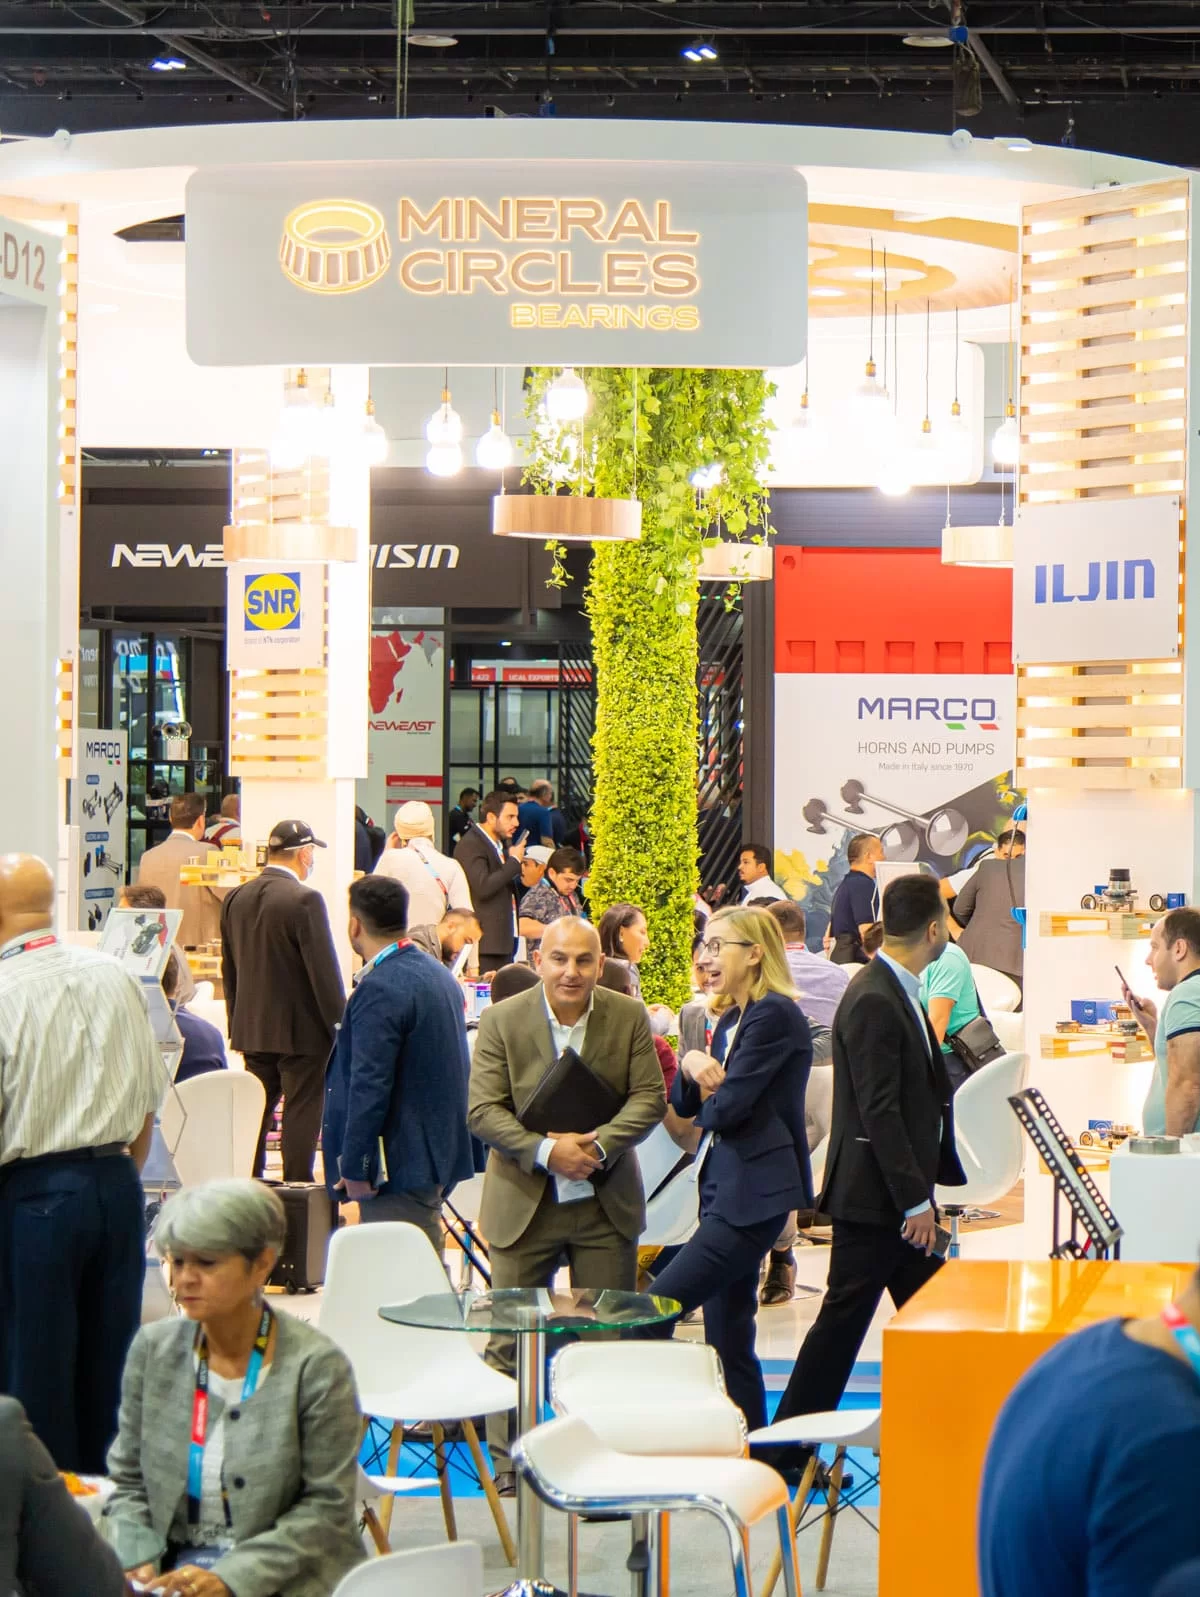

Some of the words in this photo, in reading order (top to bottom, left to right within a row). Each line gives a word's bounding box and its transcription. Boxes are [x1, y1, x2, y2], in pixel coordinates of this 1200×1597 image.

[399, 197, 699, 244] MINERAL
[400, 250, 699, 296] CIRCLES
[510, 303, 699, 330] BEARINGS
[247, 588, 297, 615] SNR
[858, 697, 996, 721] MARCO
[86, 742, 121, 759] MARCO
[858, 741, 907, 754] HORNS
[911, 742, 941, 755] AND
[946, 743, 995, 755] PUMPS
[878, 762, 900, 771] Made
[902, 762, 910, 771] in
[911, 763, 929, 773] Italy
[930, 763, 953, 771] since
[954, 763, 974, 771] 1970
